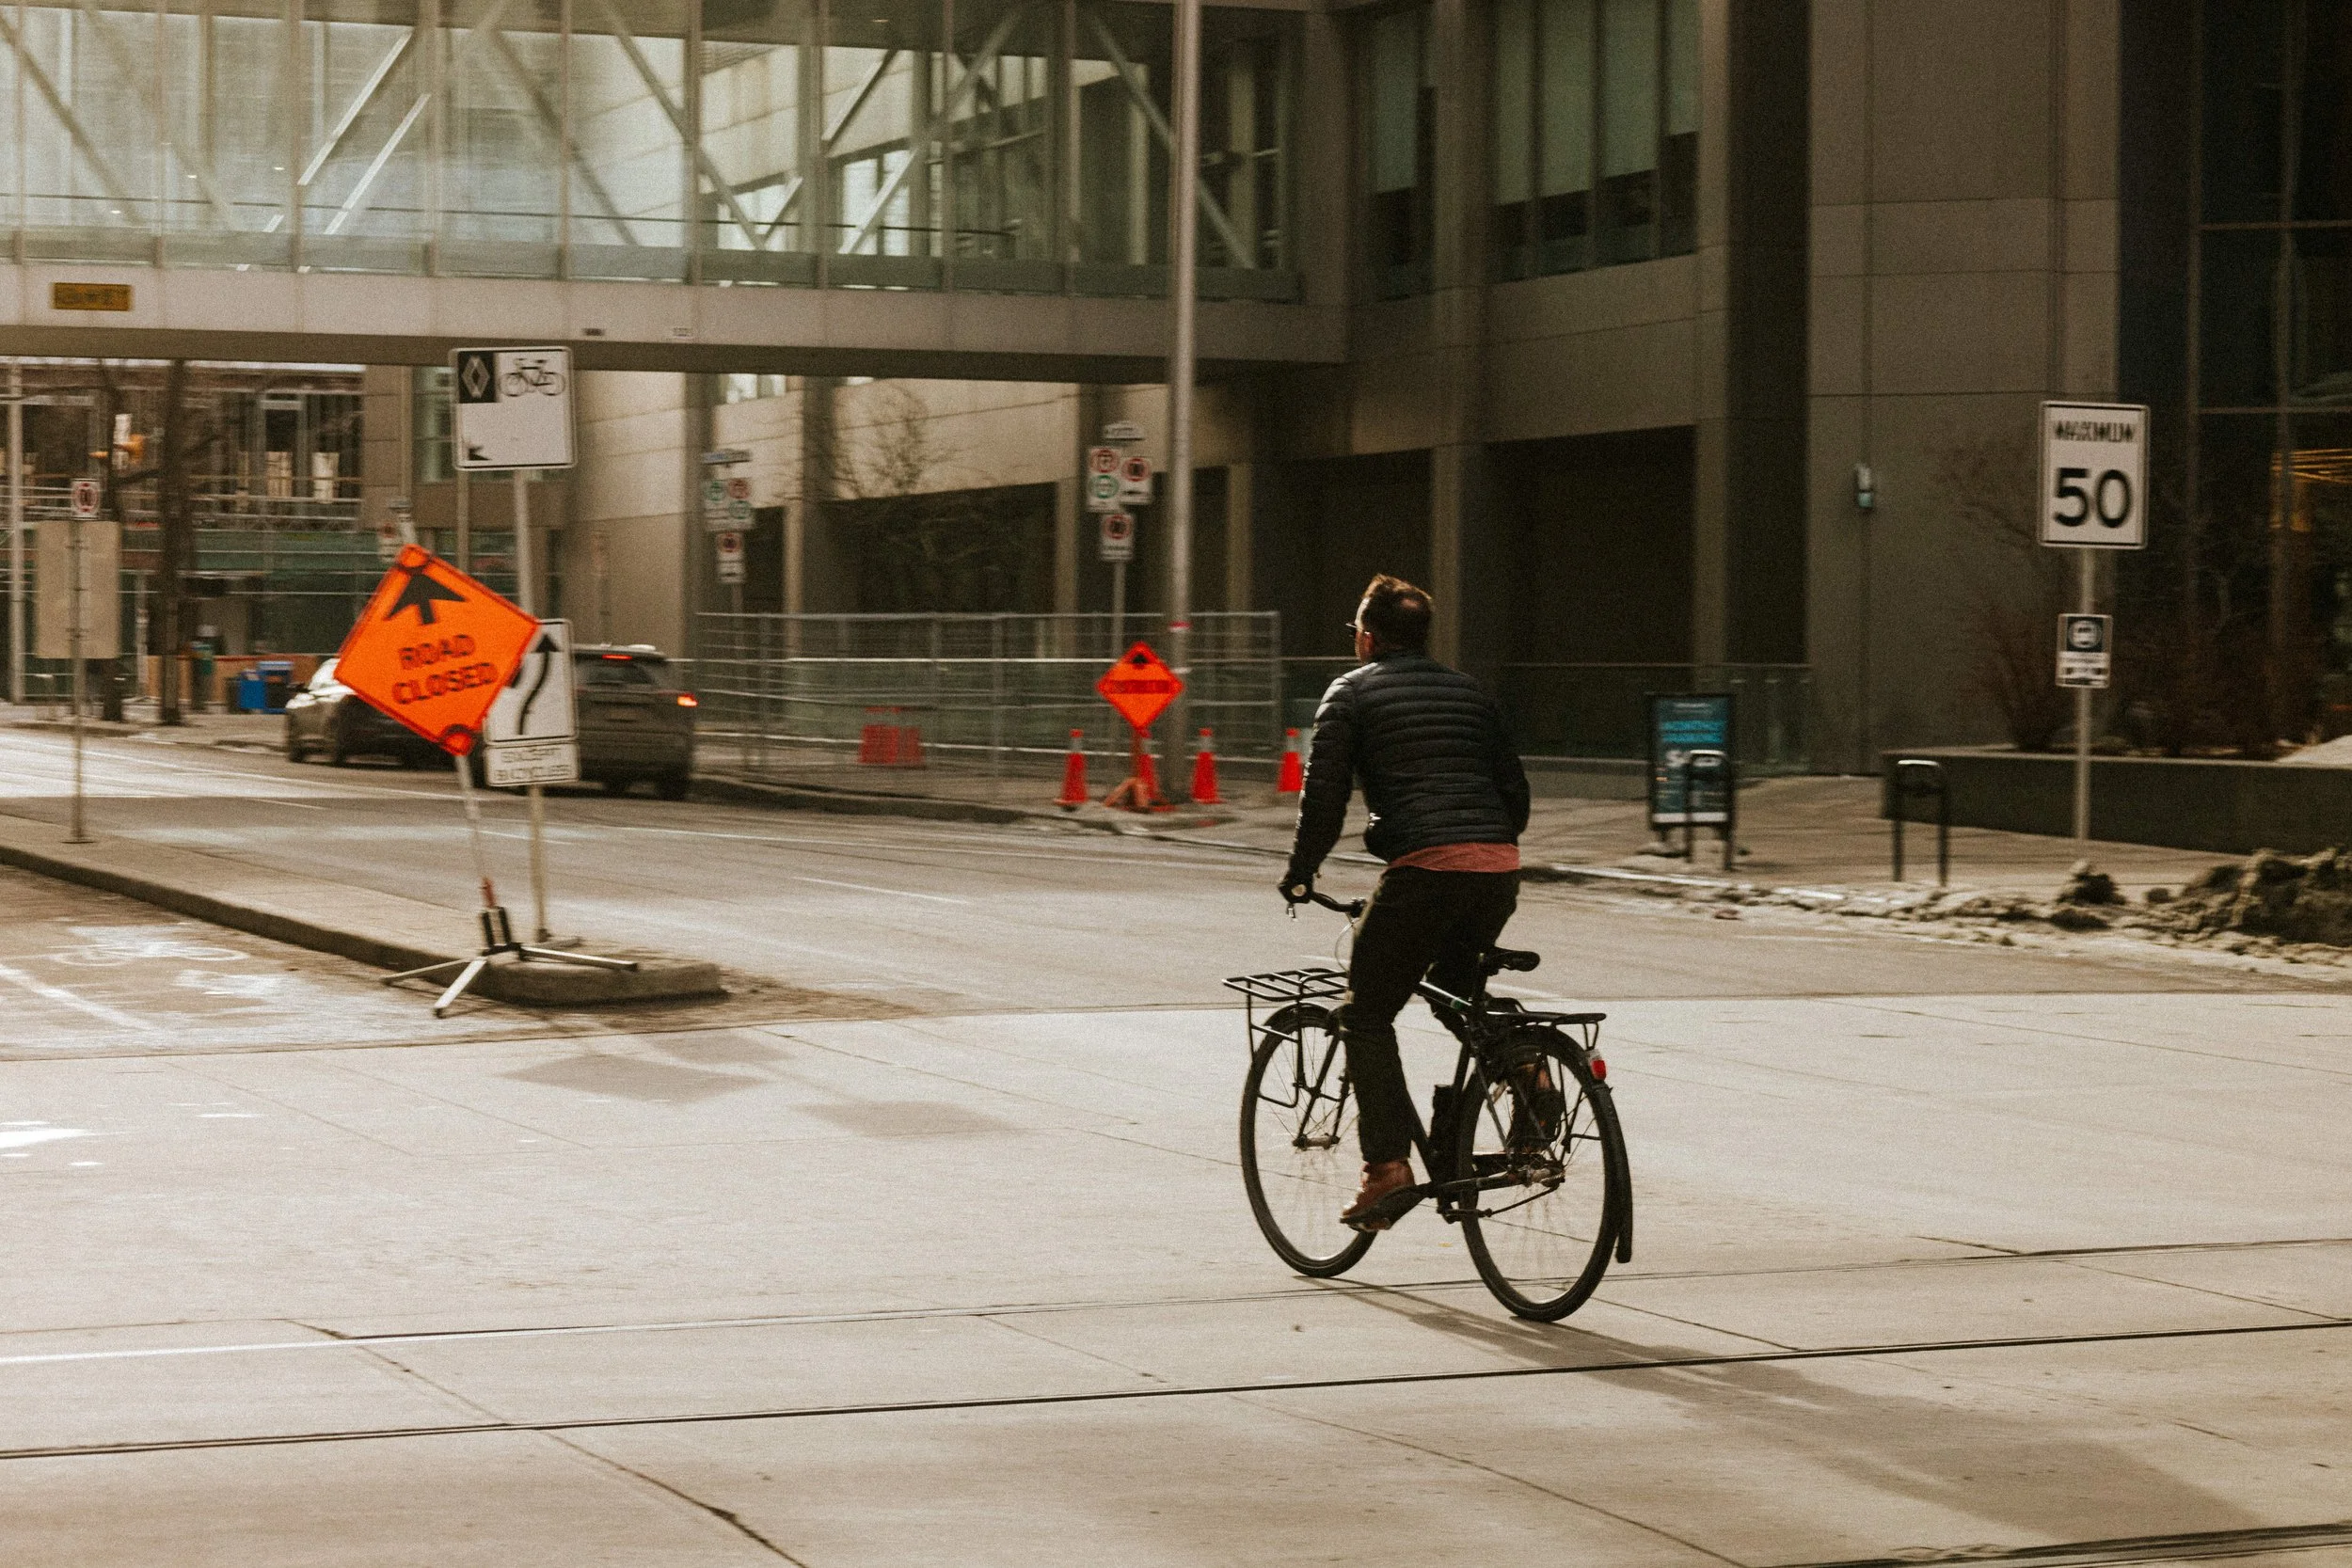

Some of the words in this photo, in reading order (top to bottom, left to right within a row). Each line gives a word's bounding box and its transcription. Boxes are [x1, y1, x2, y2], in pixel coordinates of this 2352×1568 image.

[2054, 420, 2135, 443] MAXIMUM
[2053, 467, 2133, 529] 50
[398, 633, 475, 671] ROAD
[391, 661, 499, 705] CLOSED
